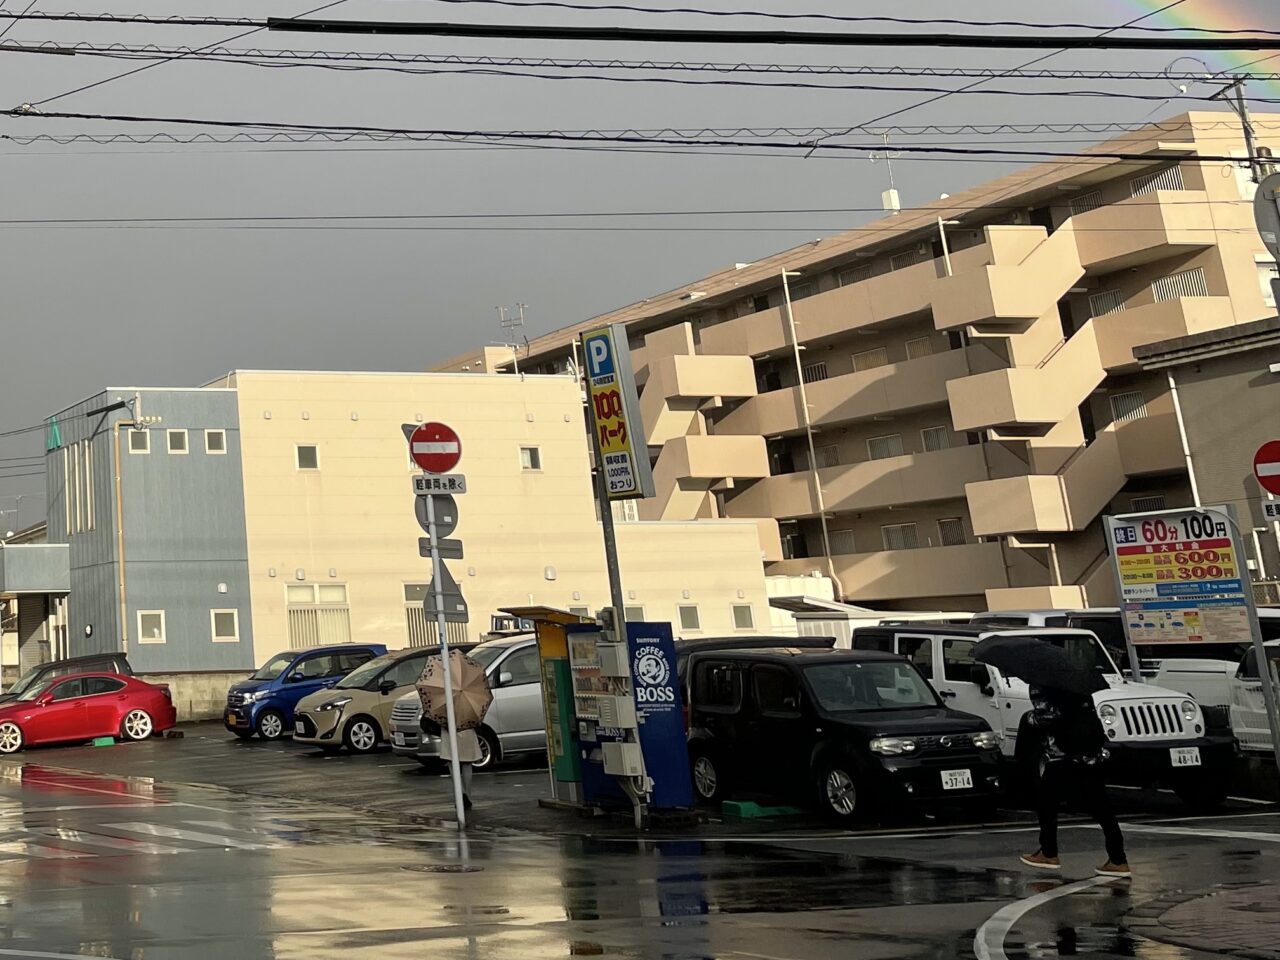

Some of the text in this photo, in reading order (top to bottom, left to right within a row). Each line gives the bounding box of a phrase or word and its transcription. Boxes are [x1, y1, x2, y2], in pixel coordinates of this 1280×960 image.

[589, 339, 608, 374] P
[415, 478, 463, 490] 軽車両を除く
[610, 479, 632, 490] おつり
[1142, 519, 1178, 543] 60分
[1181, 515, 1227, 539] 100円
[636, 646, 664, 658] COFFEE
[636, 686, 674, 702] BOSS
